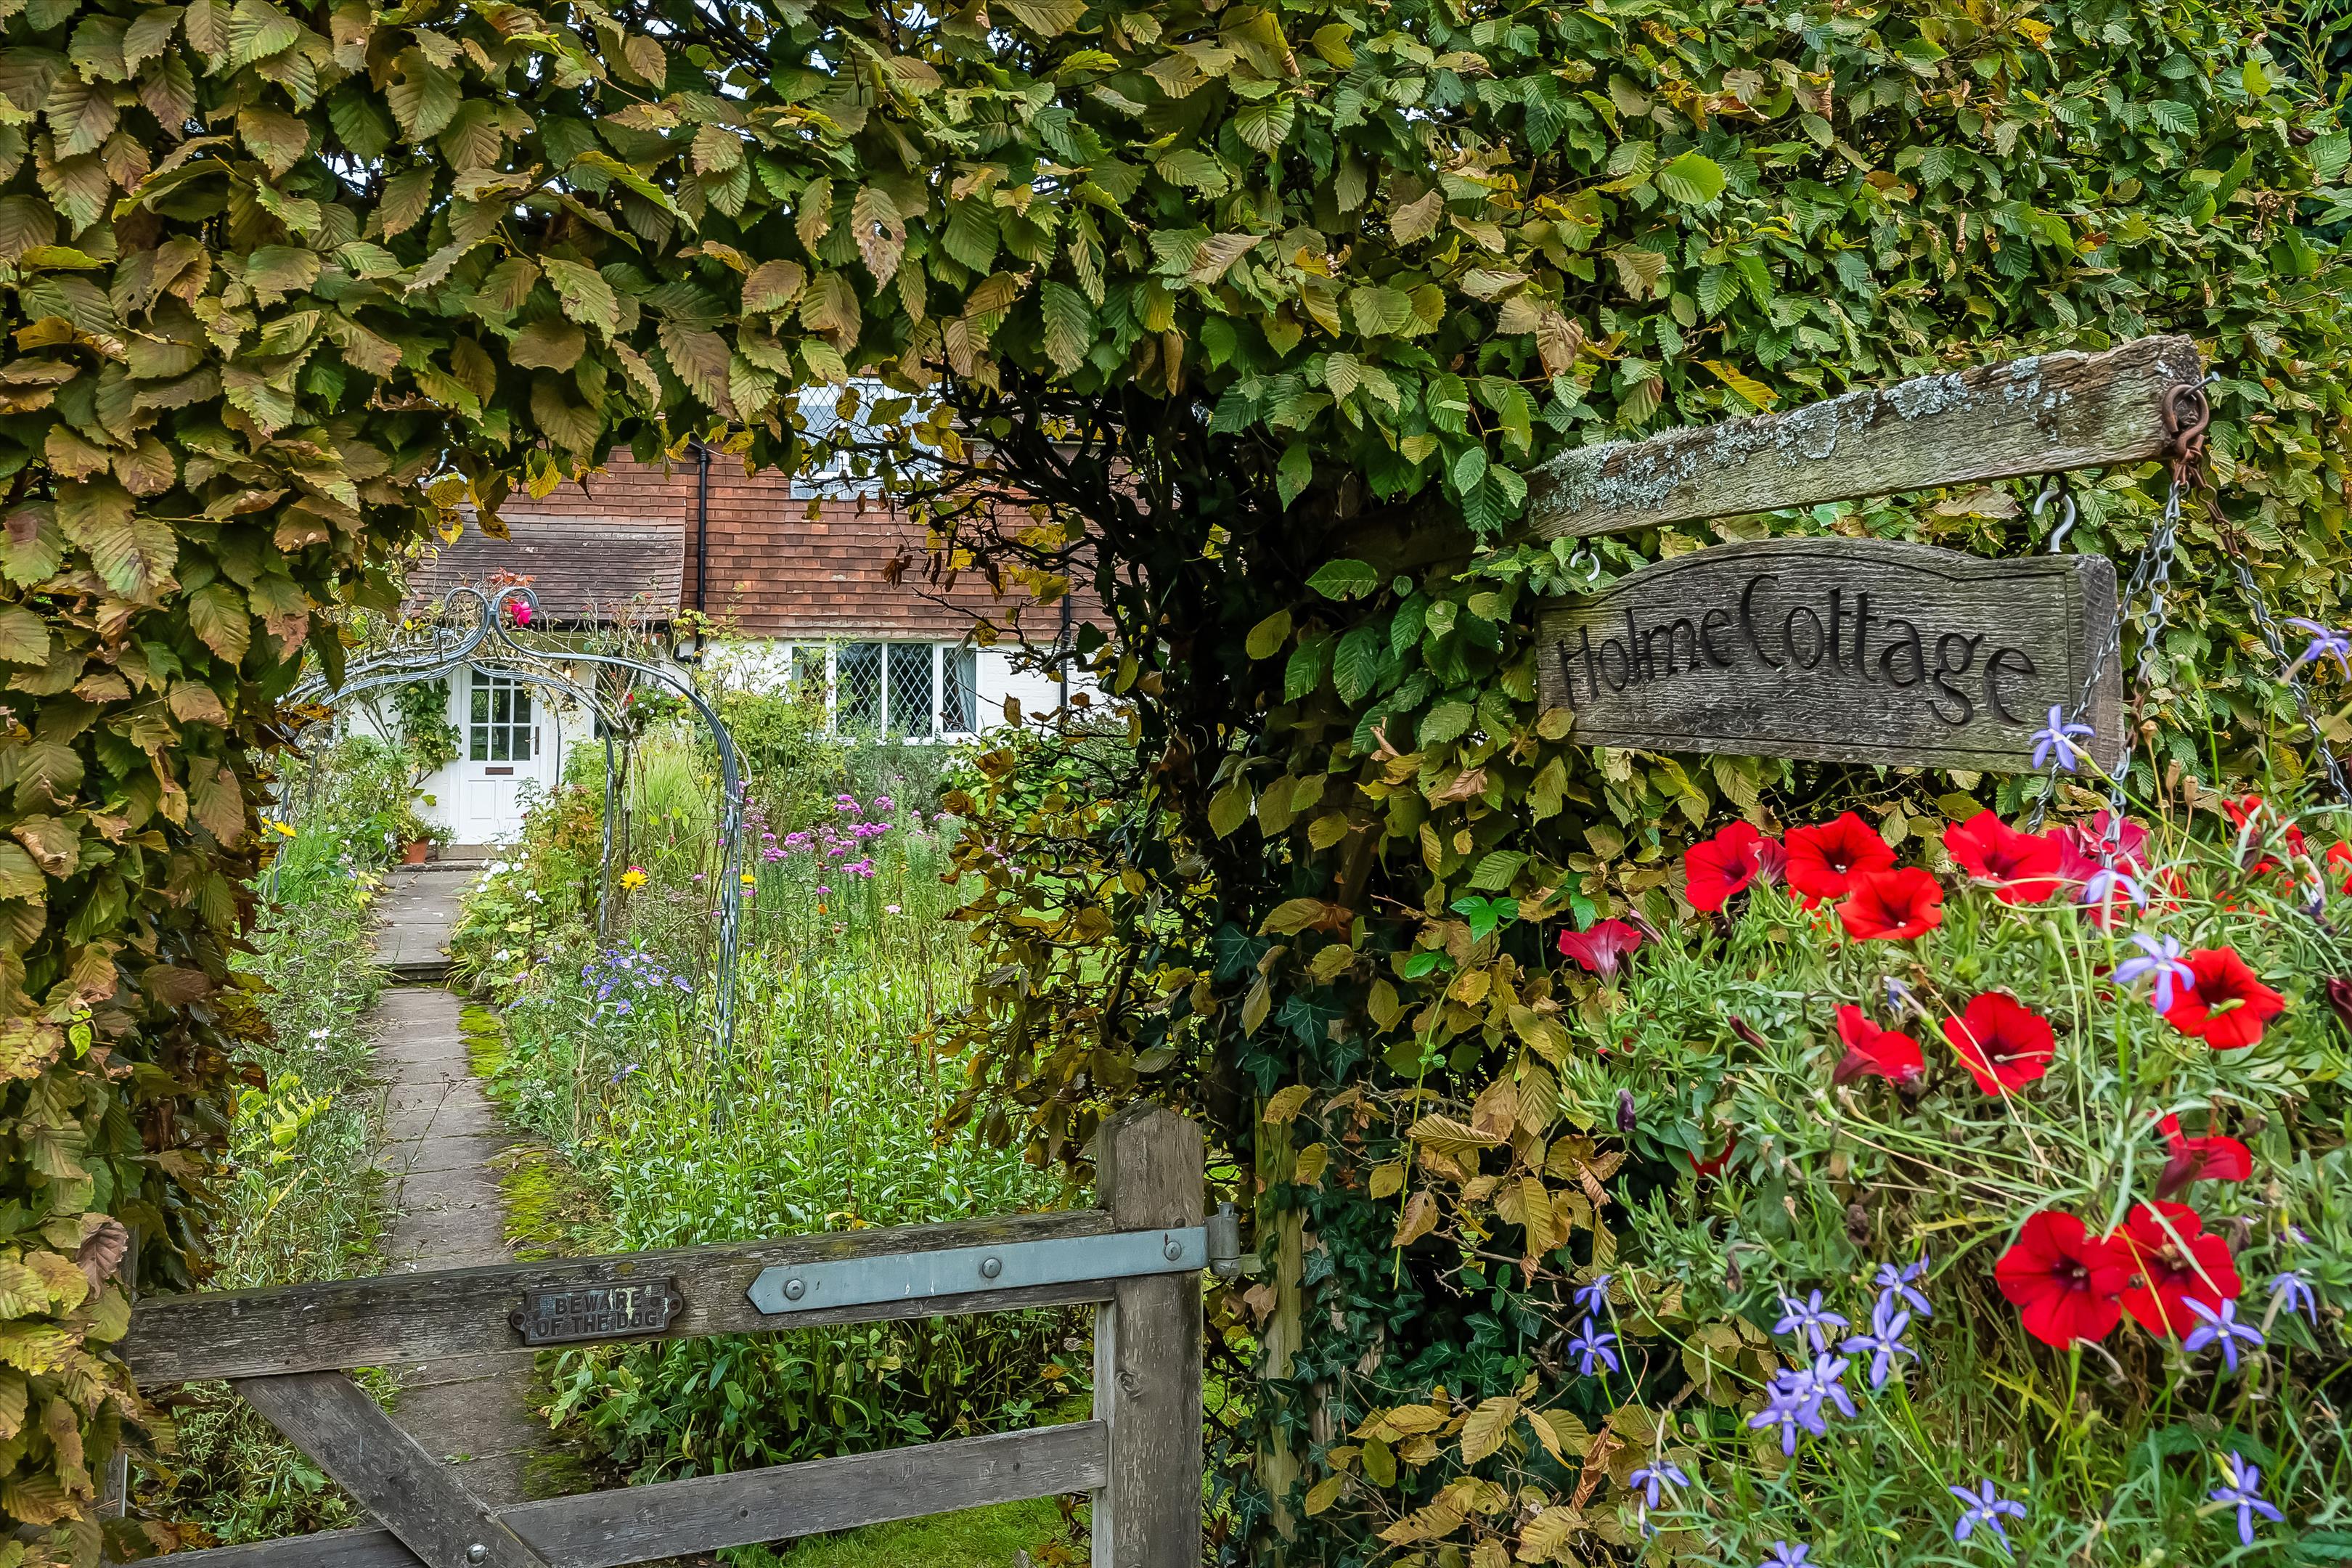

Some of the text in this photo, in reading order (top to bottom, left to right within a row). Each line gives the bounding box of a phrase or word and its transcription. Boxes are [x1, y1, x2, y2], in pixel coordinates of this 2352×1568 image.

[1556, 573, 2037, 727] Holme Cottage
[555, 1290, 642, 1315] BEWARE
[536, 1309, 656, 1336] OF THE DOG
